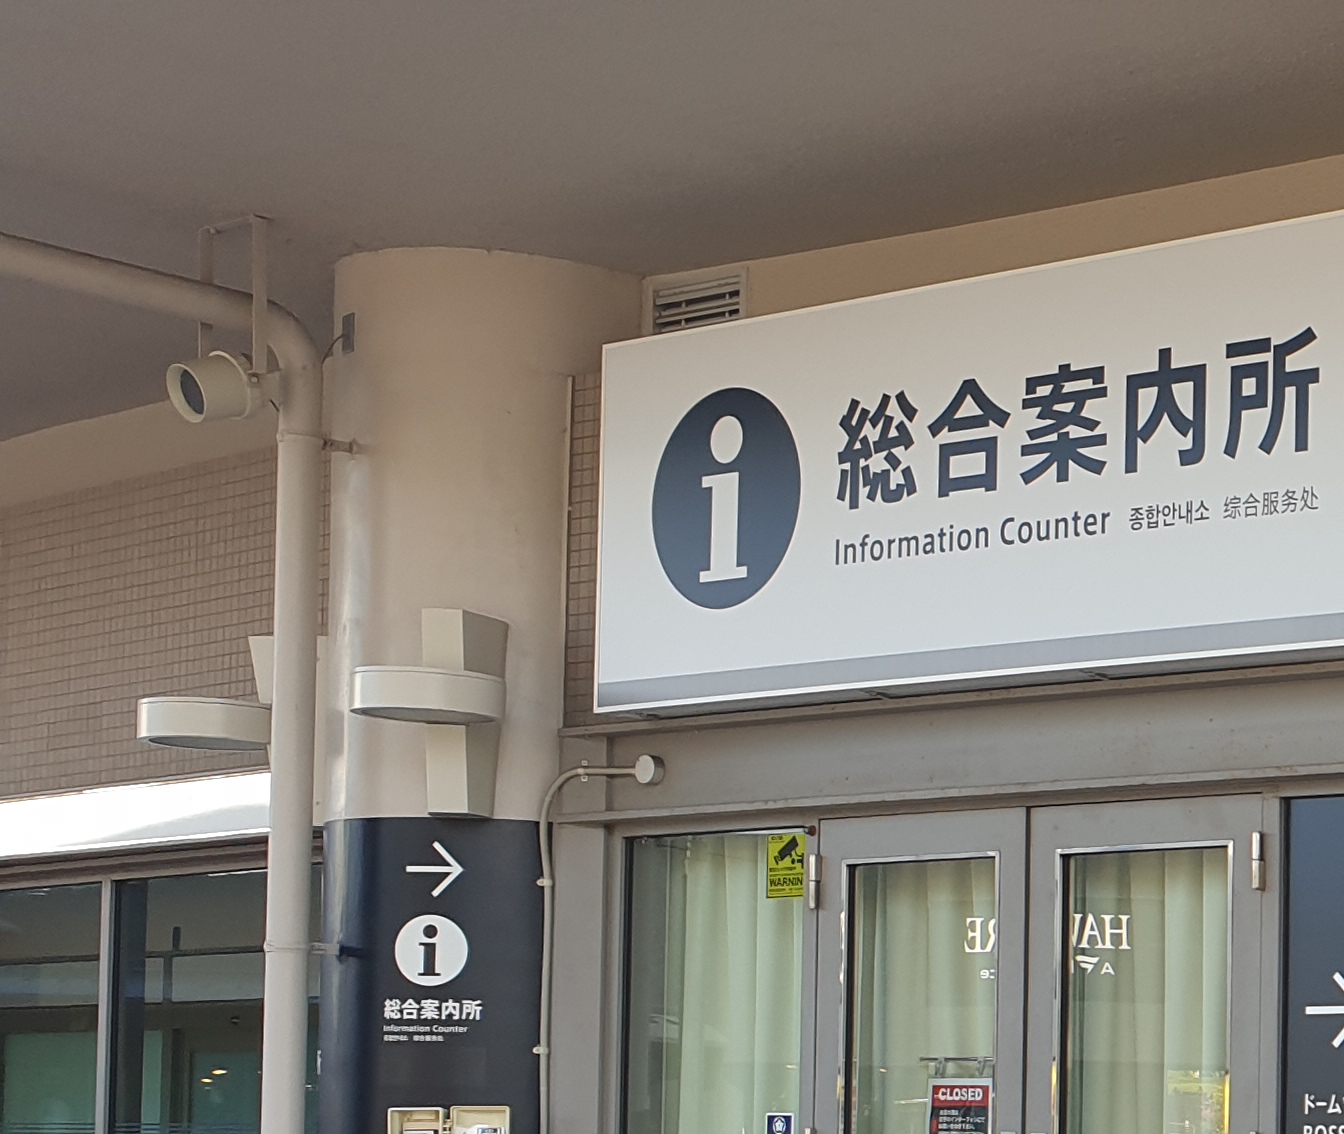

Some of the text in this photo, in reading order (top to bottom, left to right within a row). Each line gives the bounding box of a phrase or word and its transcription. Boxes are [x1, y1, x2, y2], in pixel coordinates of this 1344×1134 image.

[837, 327, 1319, 512] 総合案内所
[1129, 500, 1209, 530] 종합안내소
[1223, 486, 1318, 519] 综合服务处
[836, 511, 1110, 565] Information Counter
[770, 877, 802, 887] WARNIN
[384, 999, 482, 1020] 総合案内所
[383, 1024, 430, 1032] Information
[937, 1088, 983, 1100] CLOSED
